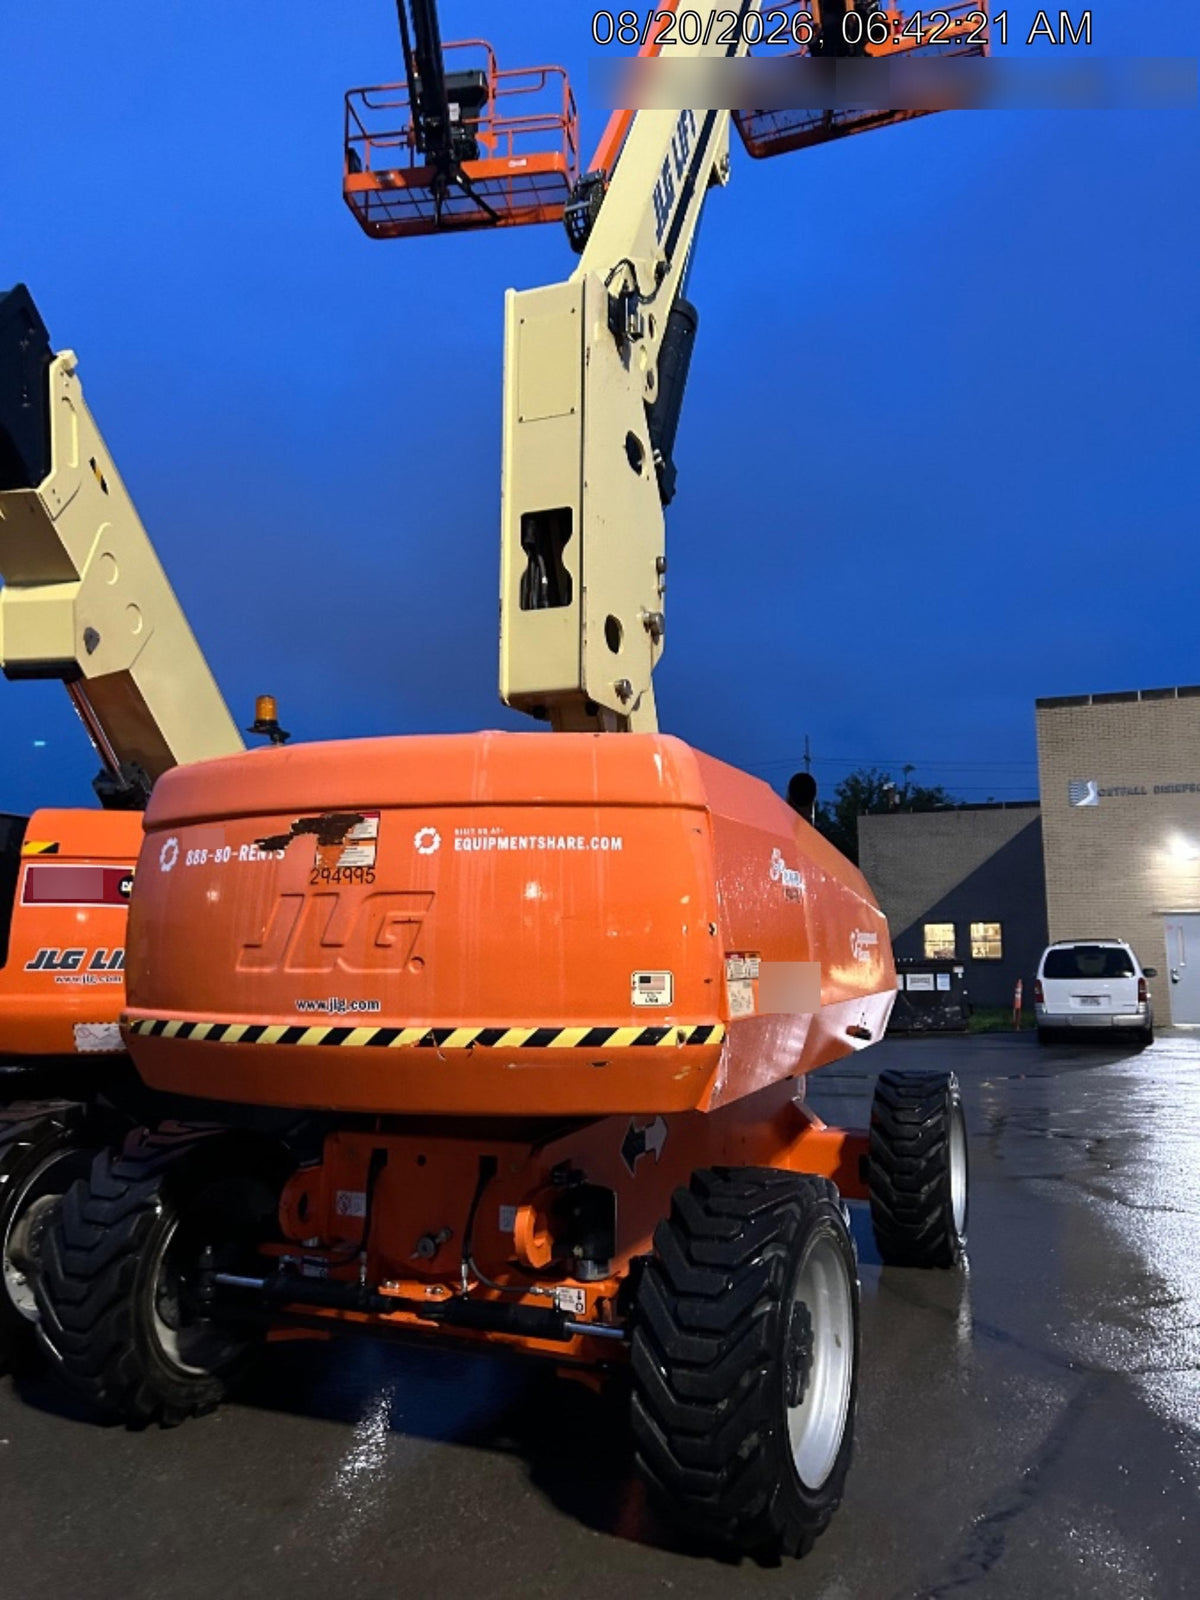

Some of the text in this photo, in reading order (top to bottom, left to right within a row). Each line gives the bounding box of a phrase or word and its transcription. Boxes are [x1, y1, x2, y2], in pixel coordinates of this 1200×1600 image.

[454, 836, 623, 851] EQUIPMENTSHARE.COM
[310, 866, 376, 885] 294995
[24, 948, 125, 971] JLG LI
[295, 998, 380, 1012] www.jlg.com
